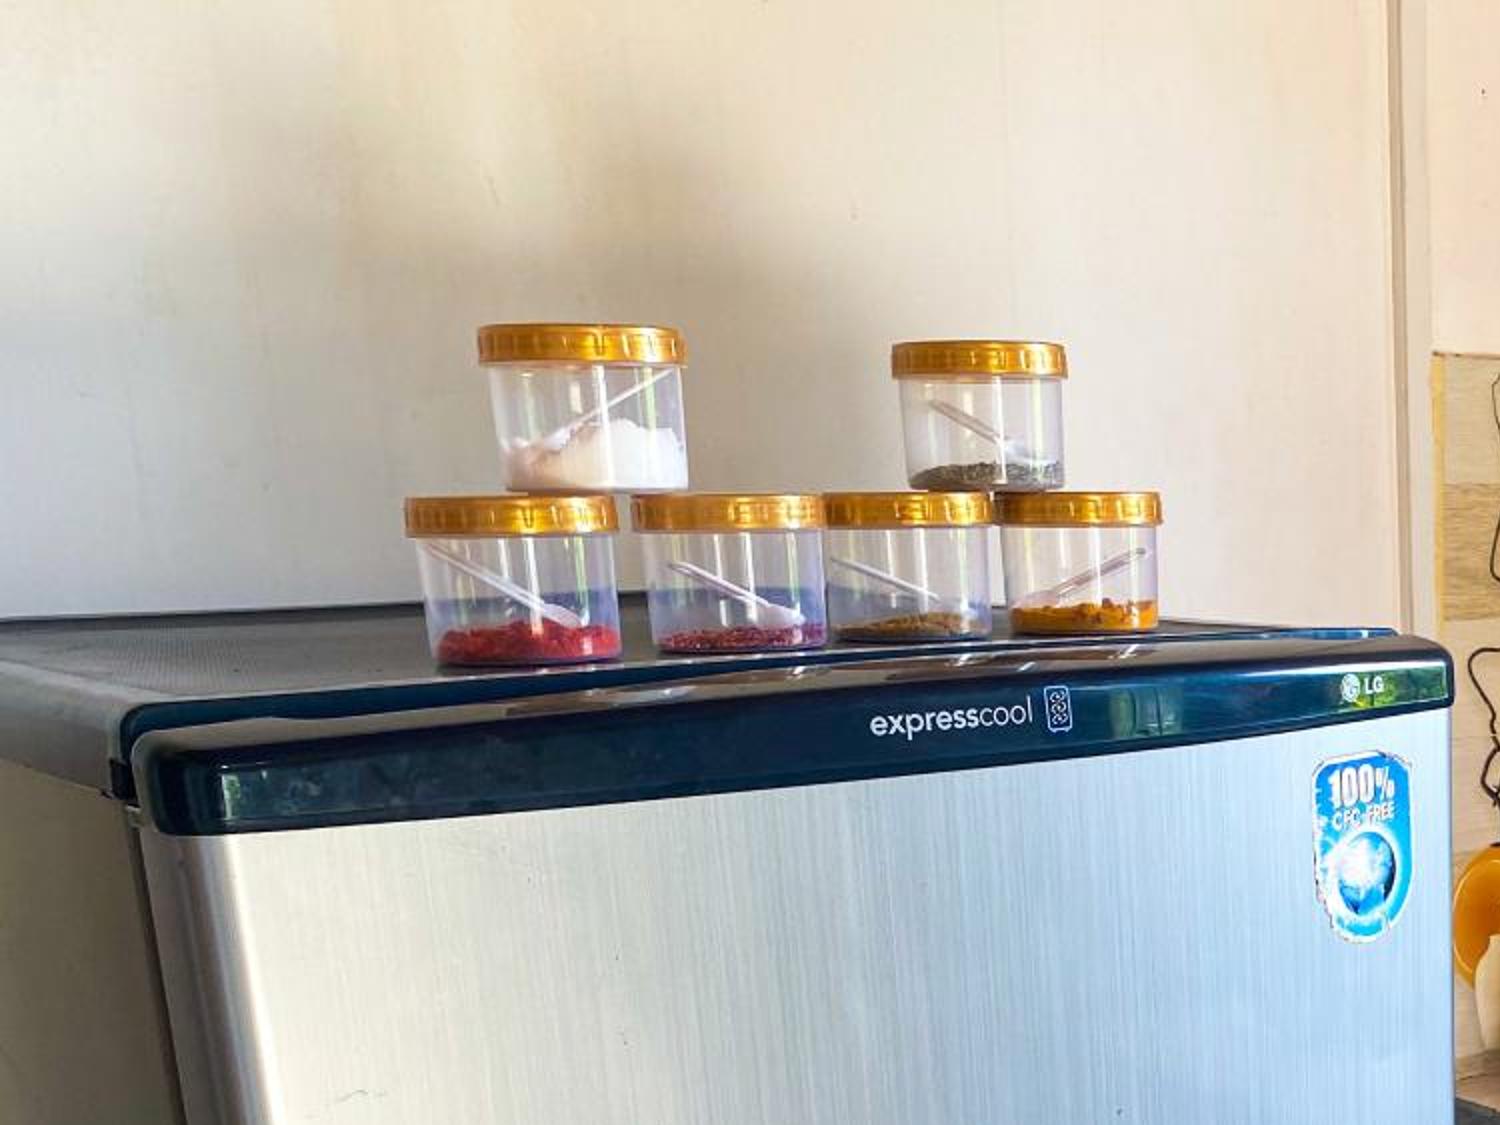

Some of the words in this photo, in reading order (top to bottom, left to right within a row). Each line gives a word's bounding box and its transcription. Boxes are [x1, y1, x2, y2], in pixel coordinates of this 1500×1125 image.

[1364, 675, 1384, 695] LG
[869, 695, 1033, 741] expresscool
[1327, 763, 1396, 808] 100%
[1366, 800, 1396, 826] FREE
